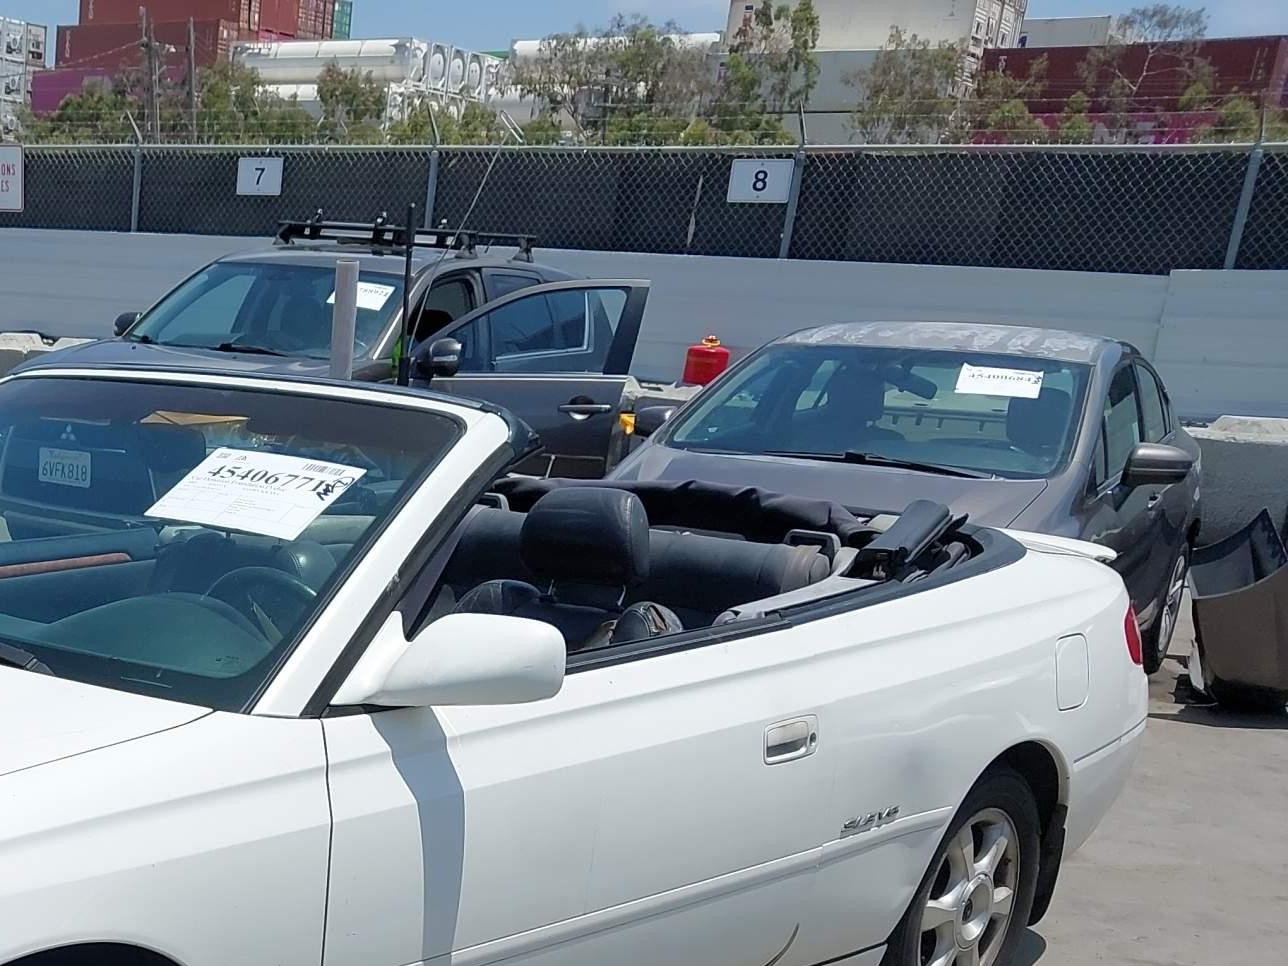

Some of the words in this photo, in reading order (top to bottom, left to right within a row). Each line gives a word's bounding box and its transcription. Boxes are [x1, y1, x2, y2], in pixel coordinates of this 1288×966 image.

[255, 167, 265, 185] 7
[752, 170, 768, 192] 8
[208, 464, 328, 492] 45406771
